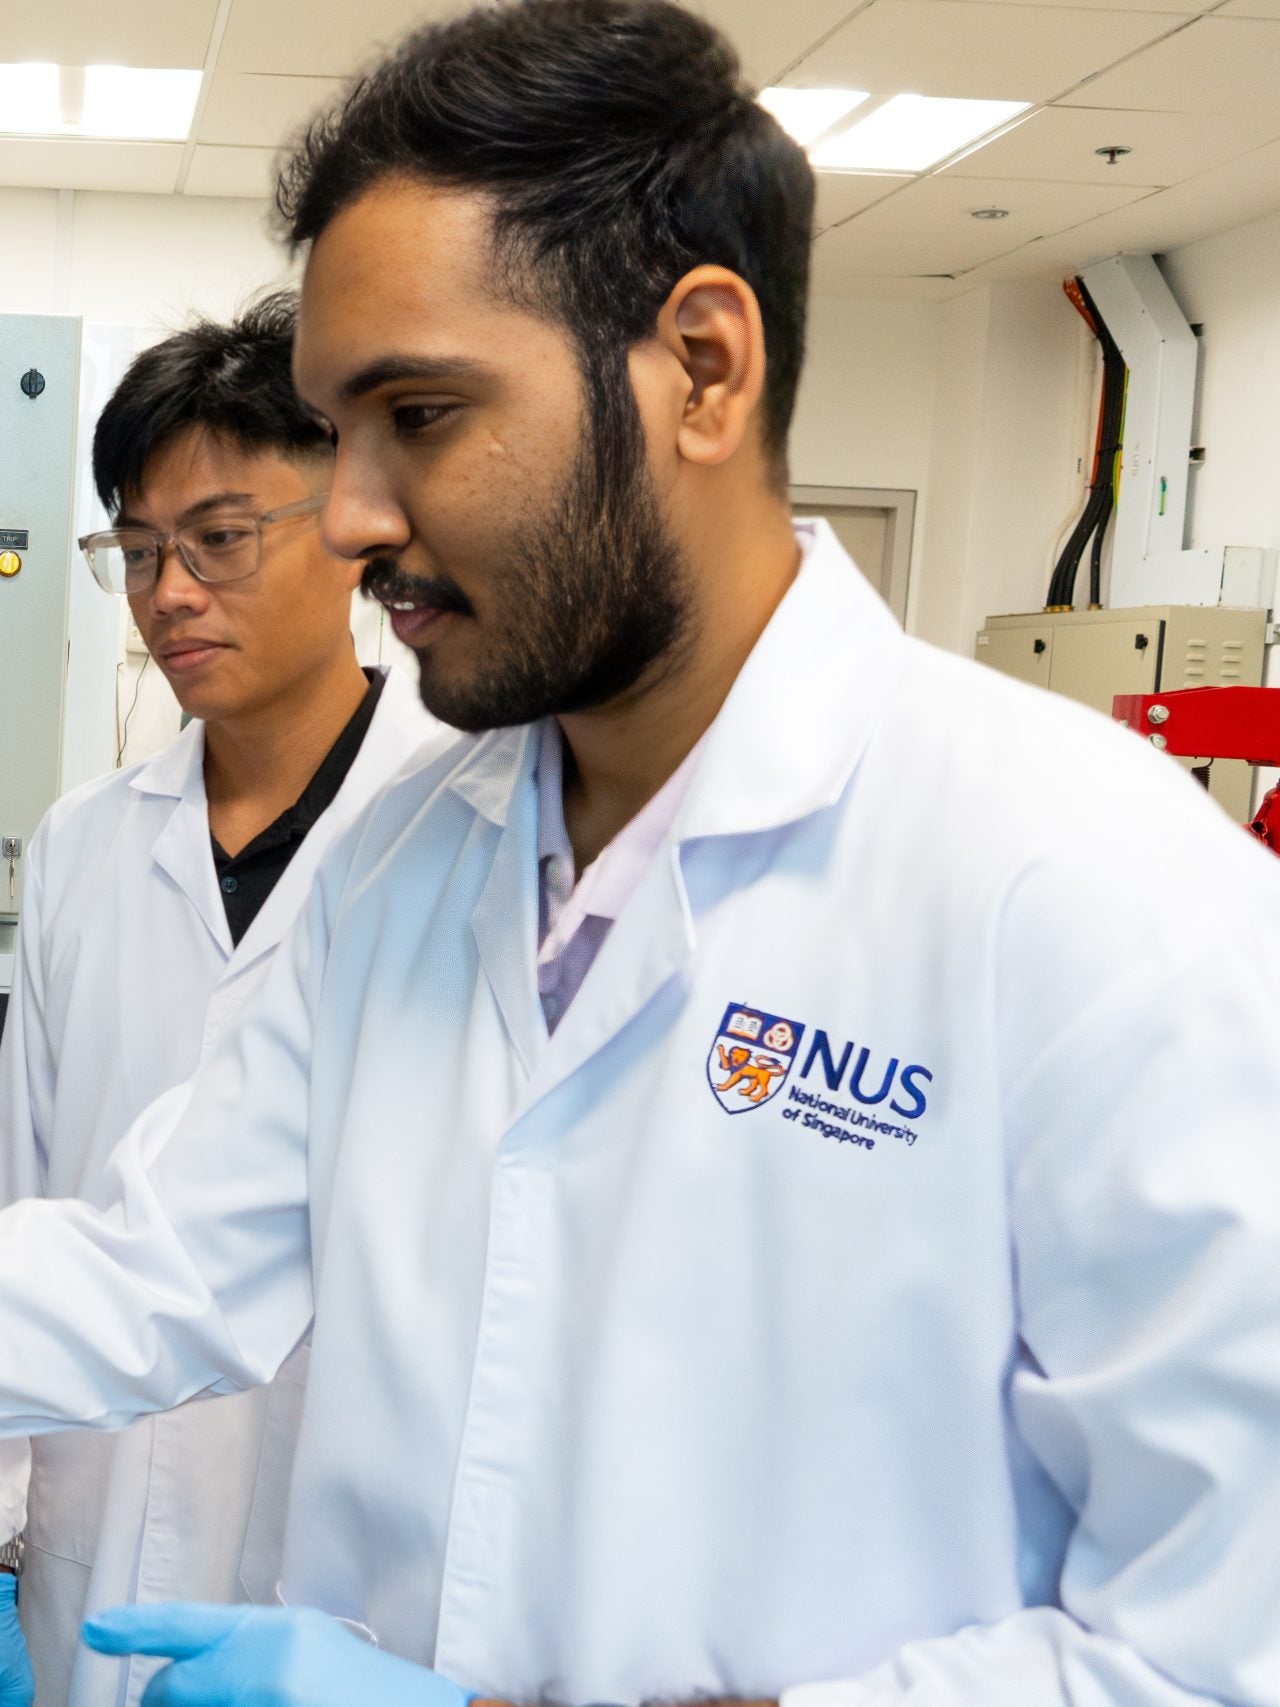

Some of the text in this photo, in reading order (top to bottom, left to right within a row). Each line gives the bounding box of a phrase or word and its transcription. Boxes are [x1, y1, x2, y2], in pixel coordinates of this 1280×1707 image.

[799, 1029, 933, 1120] NUS
[782, 1108, 875, 1150] of Singapore
[788, 1085, 918, 1146] National University
